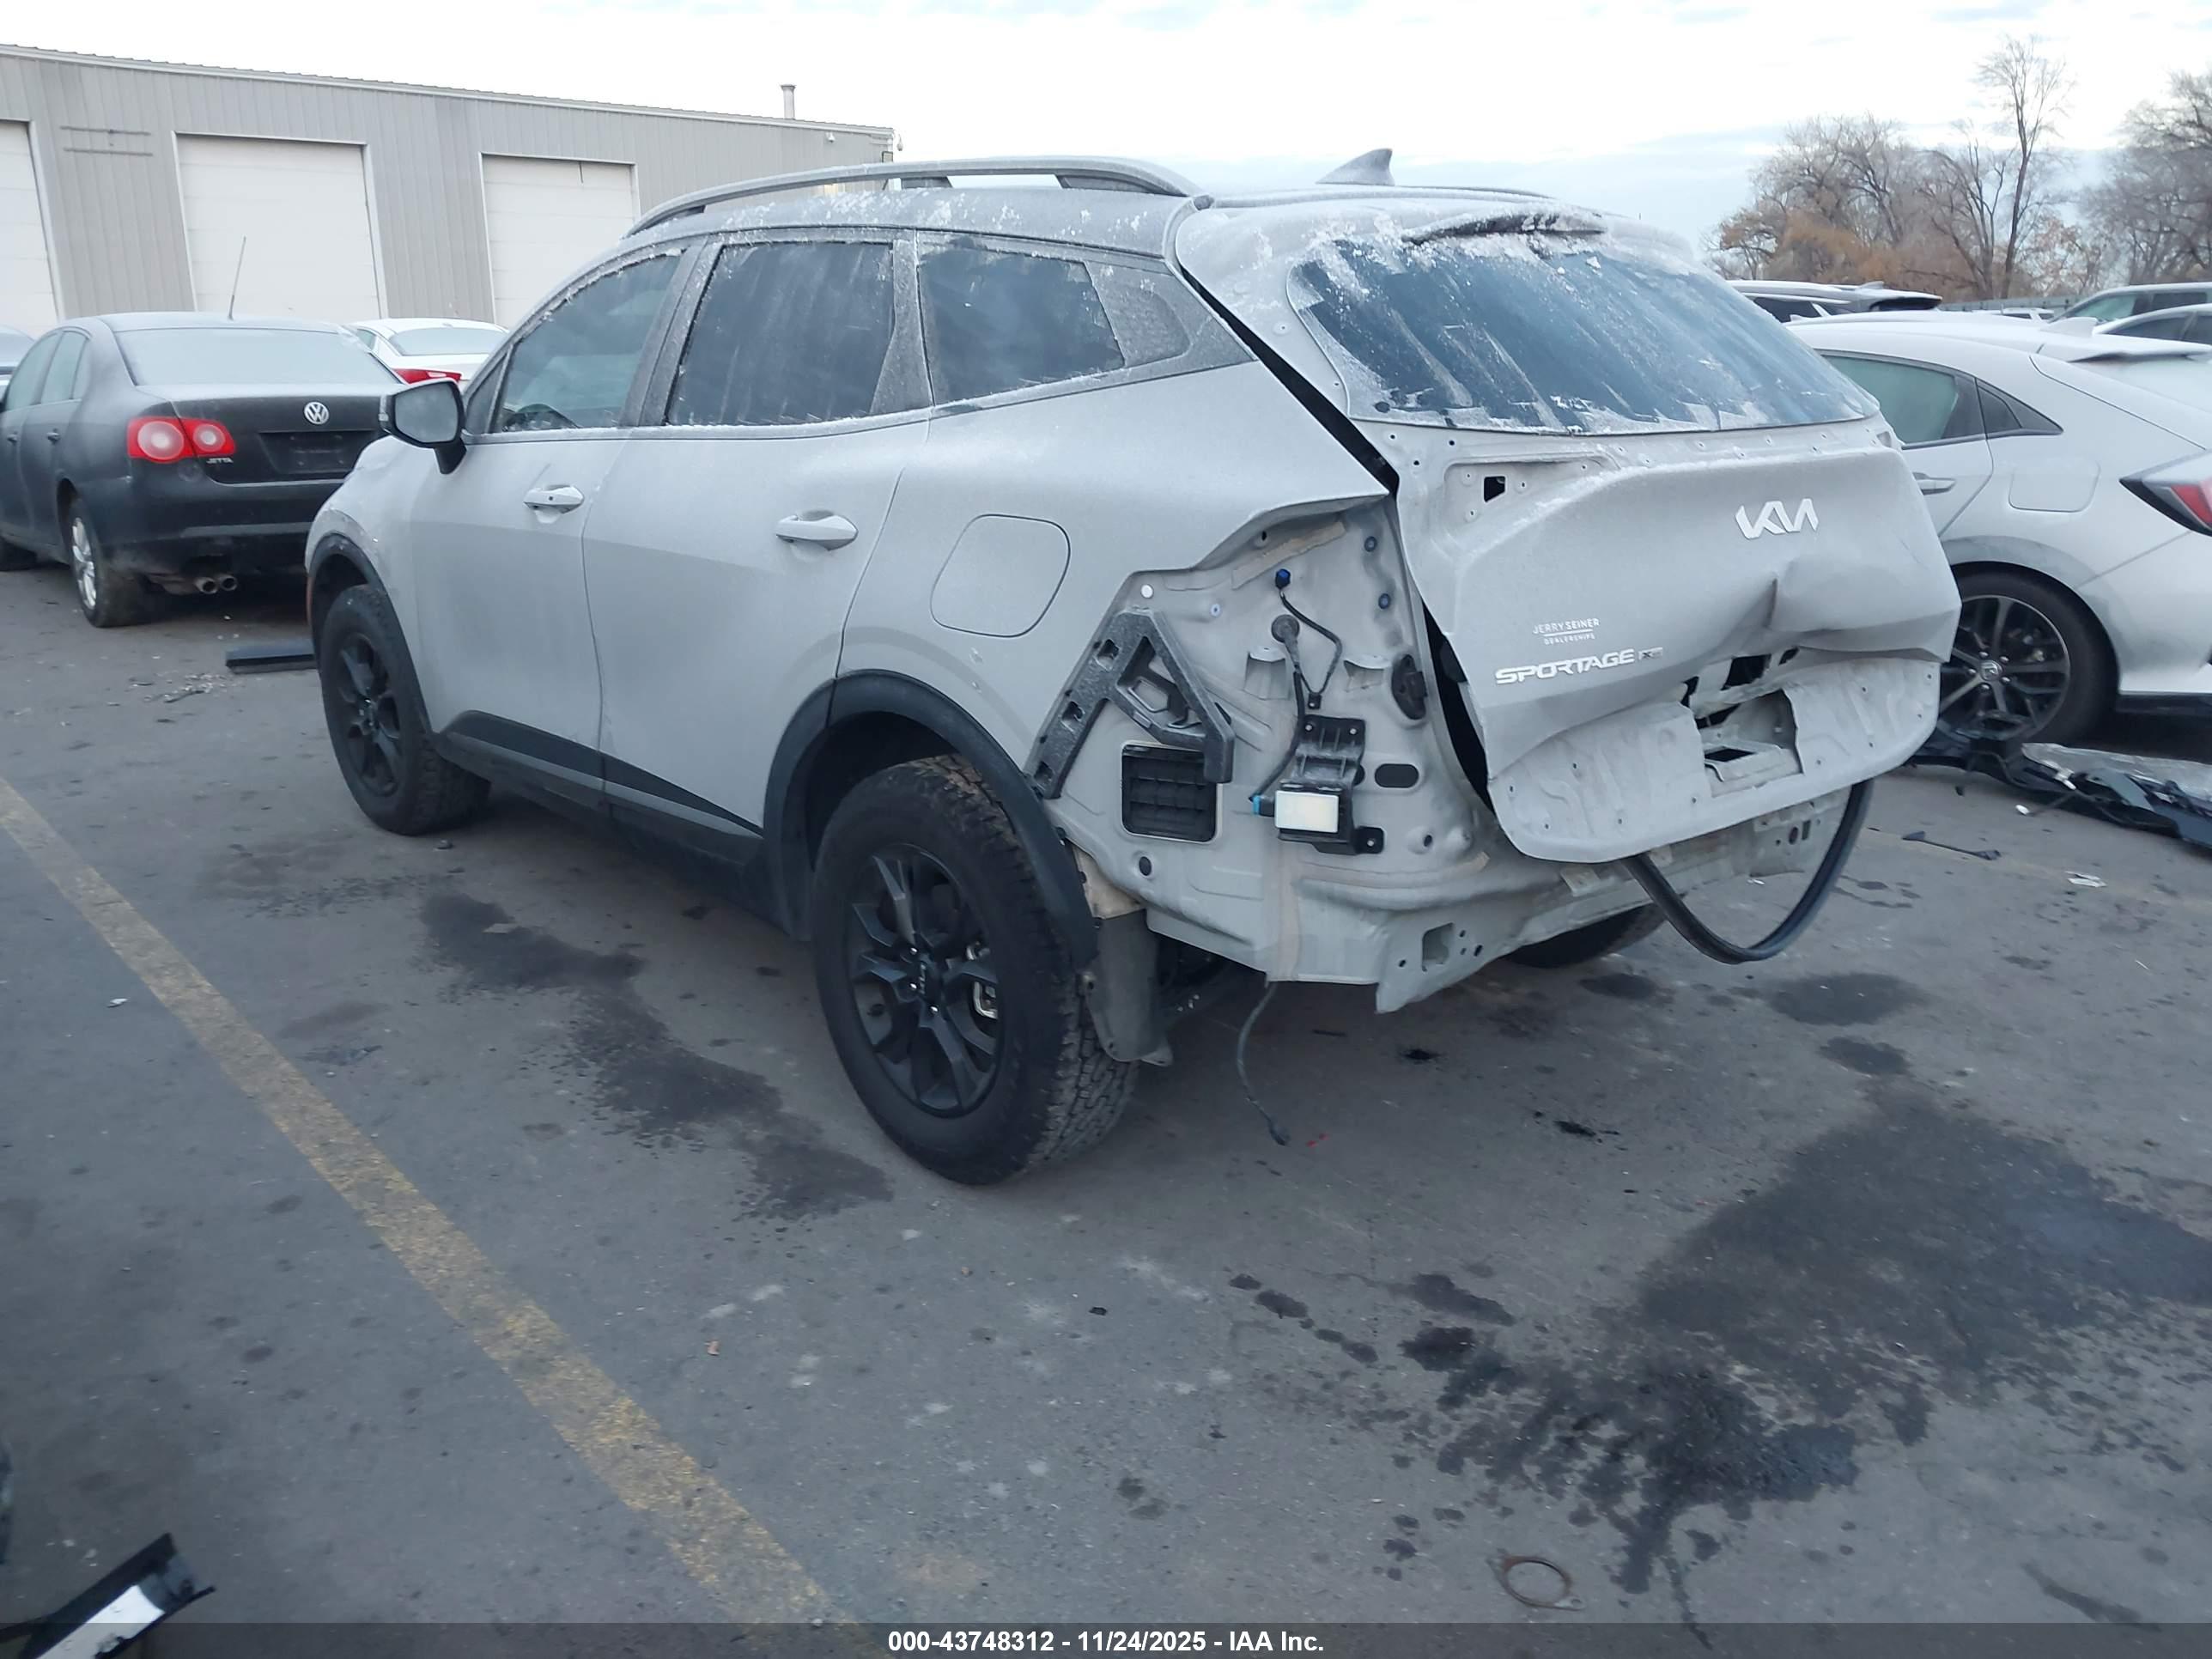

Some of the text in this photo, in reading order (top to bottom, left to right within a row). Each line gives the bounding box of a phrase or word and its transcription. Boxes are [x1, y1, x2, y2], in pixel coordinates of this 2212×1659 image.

[1735, 498, 1819, 539] KIA
[1532, 617, 1600, 635] JERRY SEINER
[1495, 648, 1635, 684] SPORTAGE
